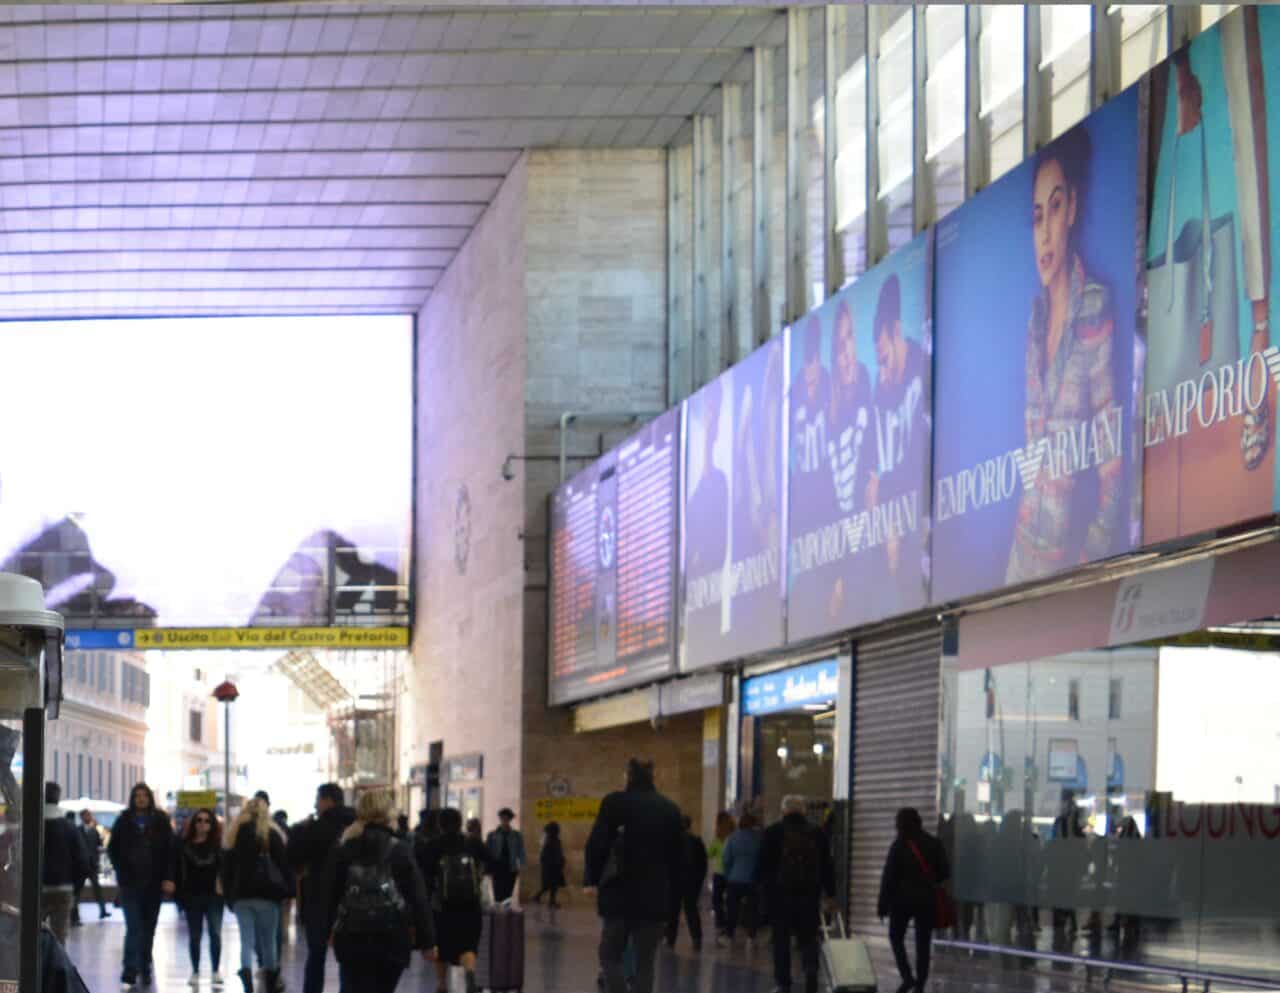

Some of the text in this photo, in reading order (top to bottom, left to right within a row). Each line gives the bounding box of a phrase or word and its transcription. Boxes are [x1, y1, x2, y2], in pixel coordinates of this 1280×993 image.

[1144, 350, 1267, 448] EMPORIO
[937, 406, 1123, 521] EMPORIO ARMANI
[236, 630, 260, 642] Via
[339, 630, 398, 641] Pretorio
